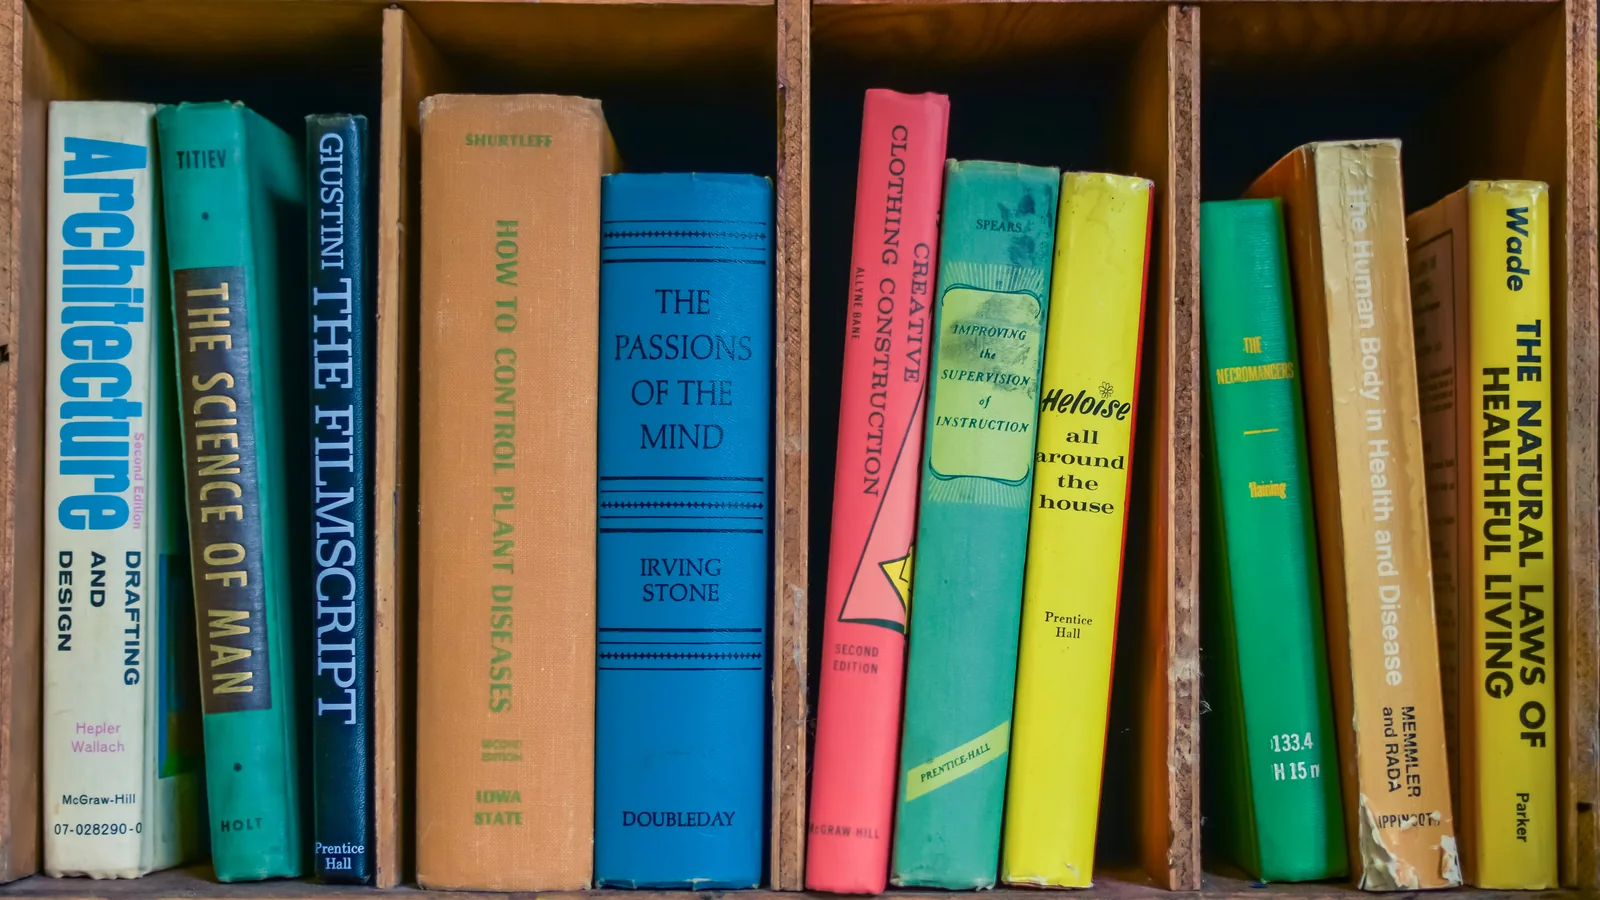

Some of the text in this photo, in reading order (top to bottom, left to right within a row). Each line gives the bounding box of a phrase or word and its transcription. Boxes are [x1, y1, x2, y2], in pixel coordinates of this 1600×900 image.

[465, 133, 552, 148] SHURTLEFF
[176, 150, 226, 169] TITIEV
[976, 219, 1022, 233] SPEARS
[655, 289, 710, 315] THE
[851, 267, 865, 340] ALLYNE BANE
[863, 124, 908, 496] CLOTHING CONSTRUCTION
[903, 242, 930, 383] CREATIVE
[58, 137, 147, 530] Architecture
[952, 324, 1026, 341] IMPROVING
[615, 334, 752, 361] PASSIONS
[979, 349, 996, 360] the
[1243, 336, 1263, 354] THE
[941, 368, 1031, 386] SUPERVISION
[1216, 362, 1295, 385] NECROMANCERS
[631, 380, 732, 406] OF THE
[979, 396, 991, 409] of
[1041, 388, 1131, 420] Heloise
[313, 133, 356, 725] GIUSTINI THE FILMSCRIPT
[936, 416, 1029, 433] INSTRUCTION
[640, 424, 724, 450] MIND
[1066, 430, 1099, 444] all
[1348, 187, 1402, 686] The Human Body in Health and Disease
[488, 220, 518, 713] HOW TO CONTROL PLANT DISEASES
[1036, 451, 1124, 470] around
[132, 433, 144, 529] Second Edition
[1057, 474, 1099, 490] the
[1506, 205, 1546, 748] Wade THE NATURAL LAWS OF
[187, 282, 254, 695] THE SCIENCE OF MAN
[1038, 494, 1114, 514] house
[1482, 367, 1513, 699] HEALTHFUL LIVING
[640, 557, 721, 577] IRVING
[90, 551, 106, 608] AND
[57, 551, 73, 652] DESIGN
[642, 583, 720, 602] STONE
[123, 551, 141, 686] DRAFTING
[1045, 611, 1093, 626] Prentice
[1055, 627, 1081, 639] Hall
[835, 643, 879, 658] SECOND
[833, 660, 879, 674] EDITION
[75, 722, 122, 738] Hepler
[71, 740, 125, 753] Wallach
[1272, 732, 1314, 752] 133.4
[1382, 706, 1402, 793] and RADA
[1401, 706, 1421, 798] MEMMLER
[920, 742, 991, 783] PRENTICE-HALL
[1273, 762, 1285, 781] H
[1289, 761, 1307, 779] 15
[62, 793, 136, 805] McGraw-Hill
[476, 790, 522, 803] IOWA
[220, 817, 263, 833] HOLT
[475, 812, 523, 825] STATE
[622, 811, 736, 828] DOUBLEDAY
[1516, 792, 1529, 843] Parker
[54, 822, 142, 836] 07-028290-0
[315, 841, 365, 855] Prentice
[325, 857, 352, 870] Hall
